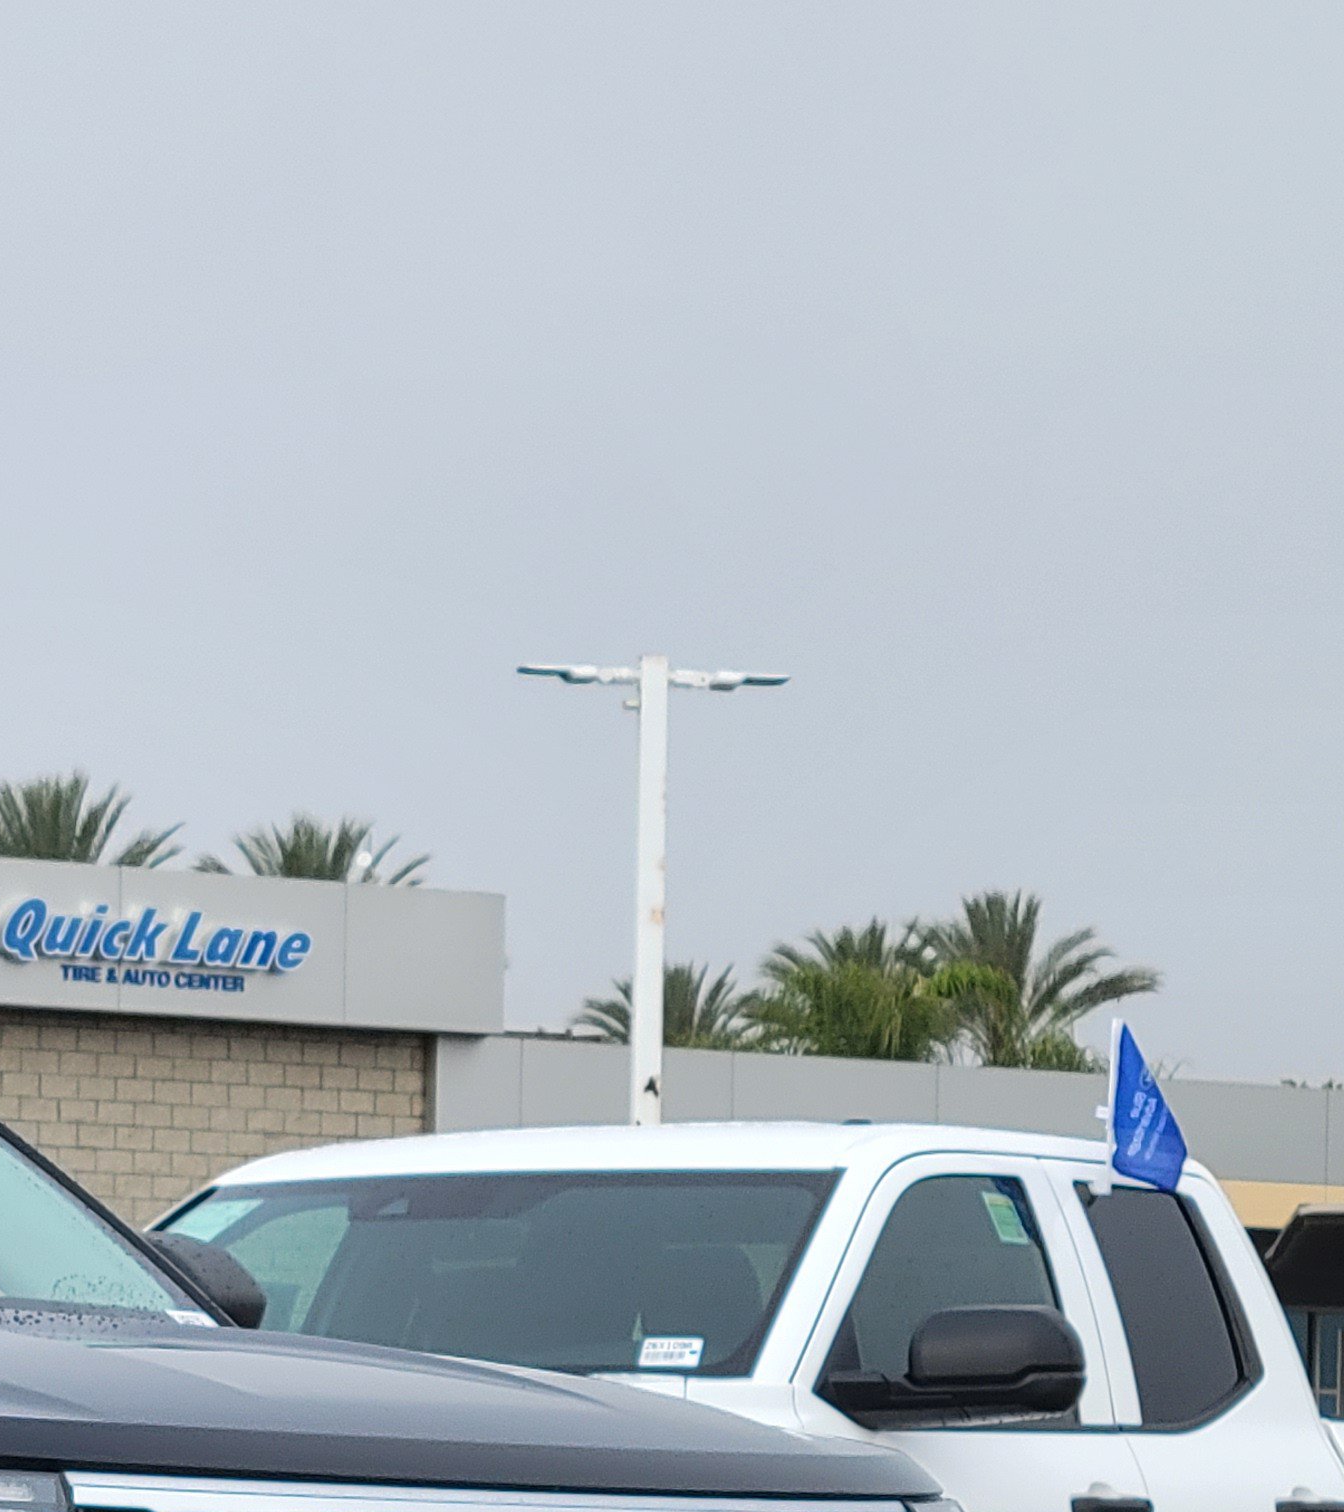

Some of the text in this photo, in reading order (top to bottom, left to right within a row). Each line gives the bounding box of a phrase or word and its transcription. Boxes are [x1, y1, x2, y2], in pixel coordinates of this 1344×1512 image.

[2, 898, 312, 970] Quick Lane
[61, 964, 244, 992] TIRE & AUTO CENTER
